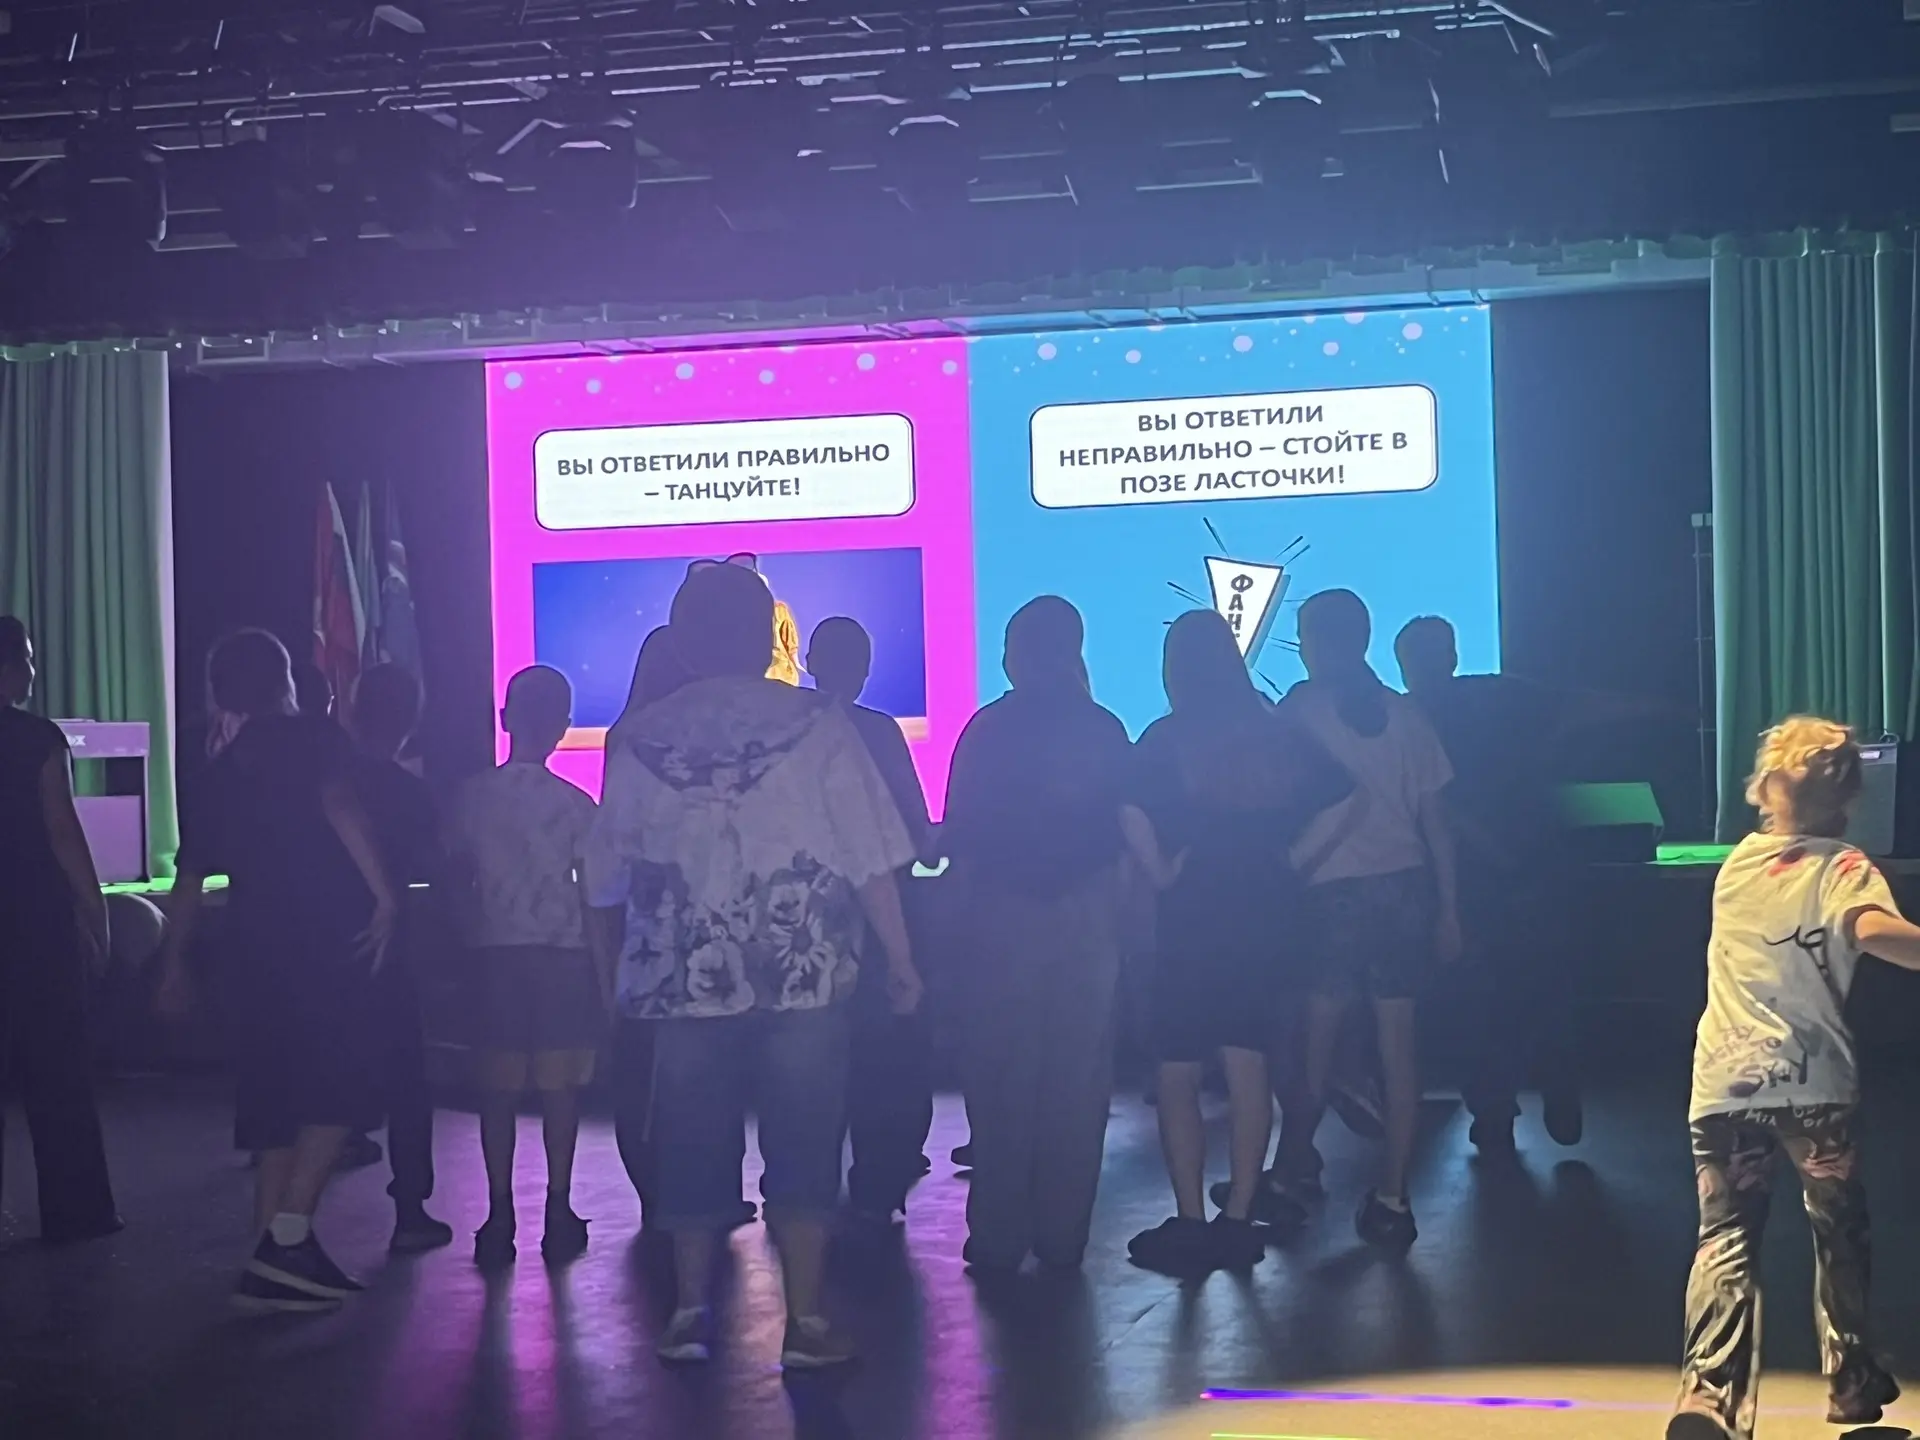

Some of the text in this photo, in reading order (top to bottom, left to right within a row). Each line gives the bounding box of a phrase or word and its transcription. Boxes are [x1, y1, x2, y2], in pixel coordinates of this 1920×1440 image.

[1137, 405, 1324, 432] ВЫ ОТВЕТИЛИ
[557, 443, 891, 476] ВЫ ОТВЕТИЛИ ПРАВИЛЬНО
[1059, 440, 1253, 467] НЕПРАВИЛЬНО
[1282, 429, 1384, 456] СТОЙТЕ
[1391, 432, 1409, 450] В
[664, 475, 801, 502] ТАНЦУЙТЕ!
[1120, 464, 1345, 494] ПОЗЕ ЛАСТОЧКИ!
[1227, 573, 1254, 638] ФАН
